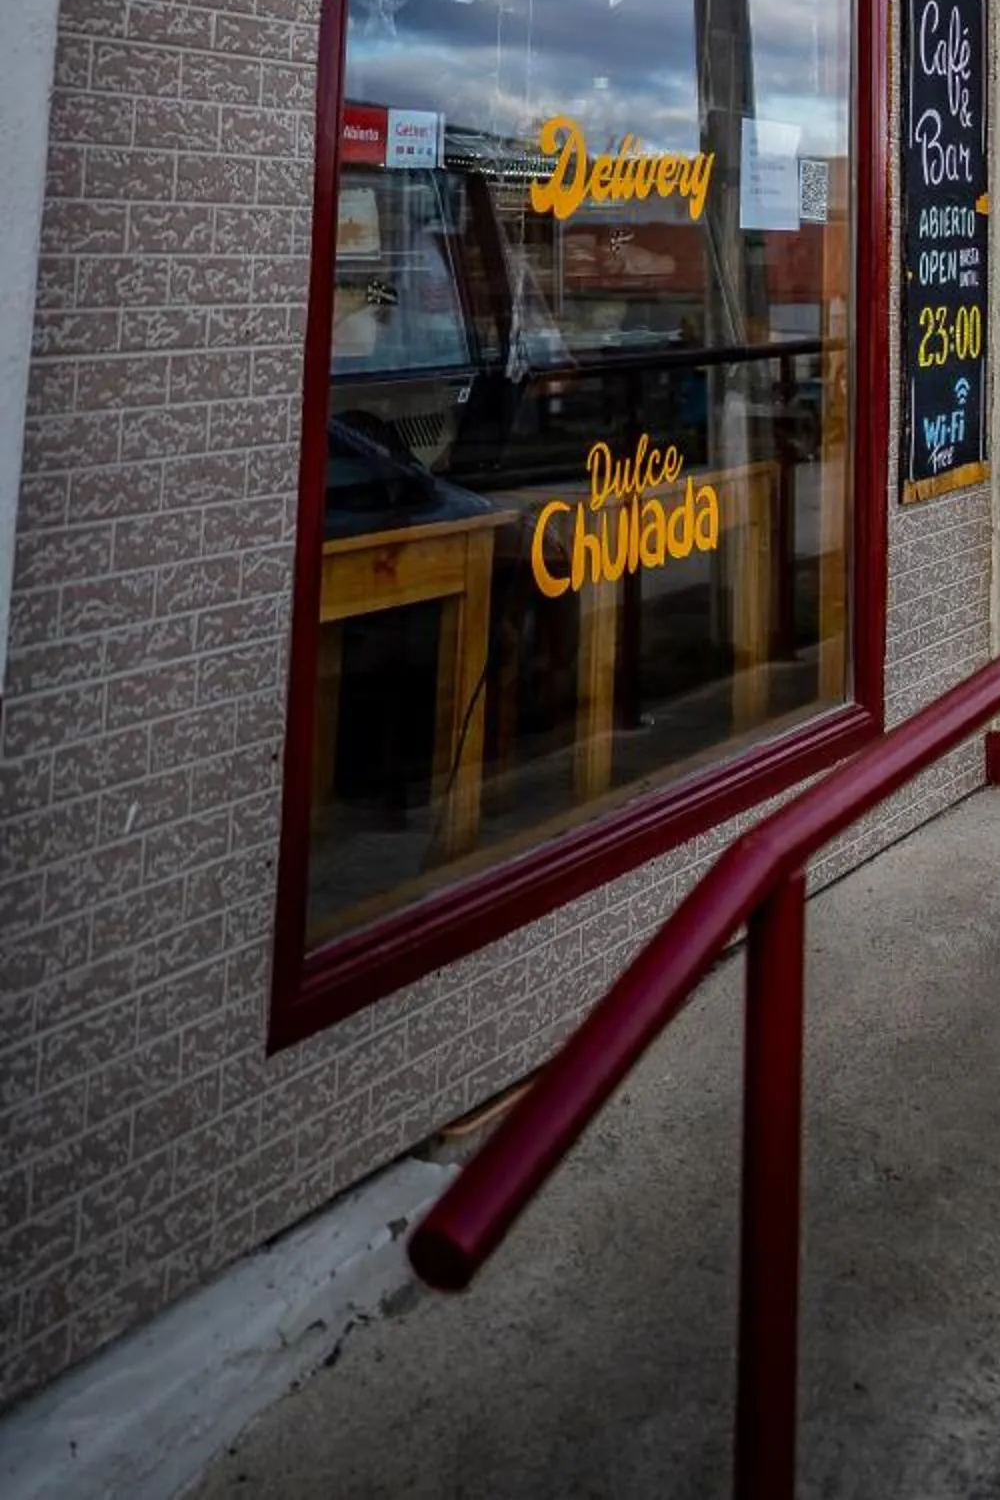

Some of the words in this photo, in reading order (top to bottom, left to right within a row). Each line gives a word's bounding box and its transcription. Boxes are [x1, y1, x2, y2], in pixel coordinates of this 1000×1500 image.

[920, 0, 971, 116] Café
[960, 88, 973, 128] &
[531, 113, 716, 220] Delivery
[915, 109, 972, 186] Bar
[919, 205, 976, 239] ABIERTO
[919, 249, 957, 285] OPEN
[918, 305, 982, 368] 23:00
[587, 434, 684, 511] Dulce
[532, 476, 719, 598] Chulada
